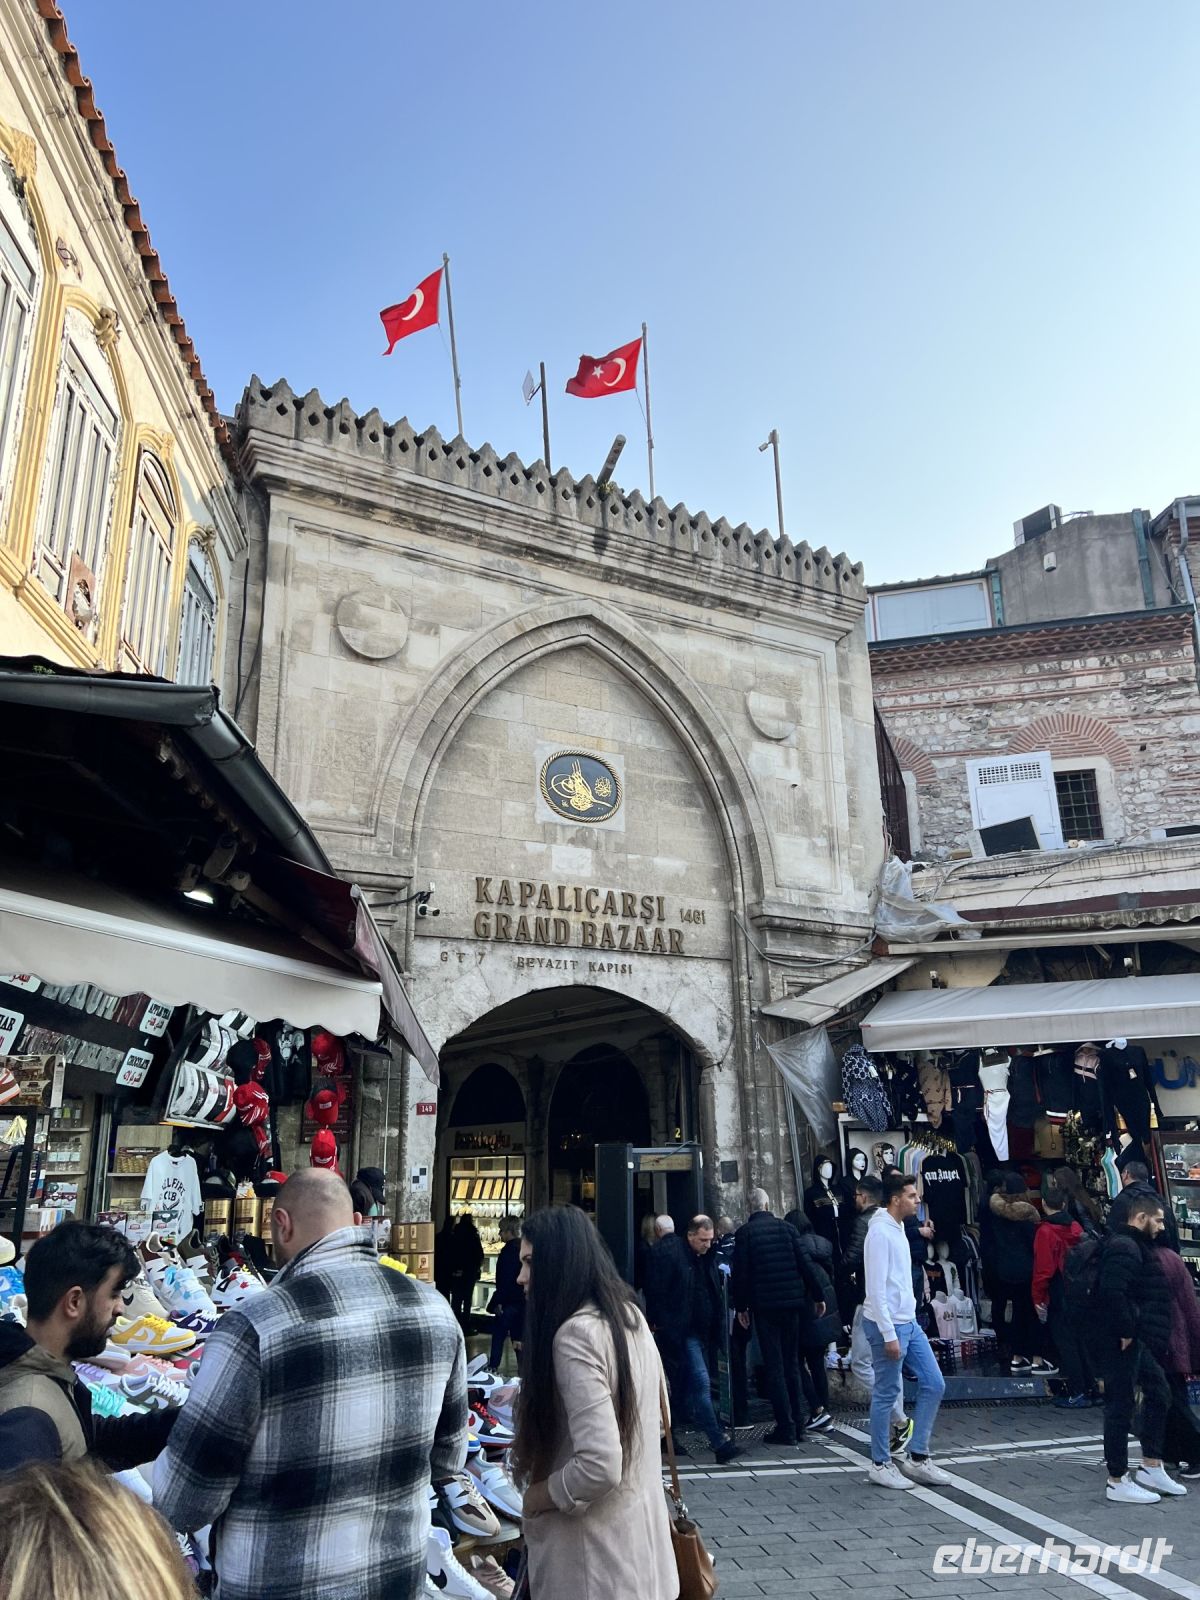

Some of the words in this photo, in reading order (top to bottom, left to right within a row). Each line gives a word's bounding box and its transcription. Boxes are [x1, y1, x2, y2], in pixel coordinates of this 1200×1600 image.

[475, 876, 666, 924] KAPALIÇARŞI
[474, 911, 571, 945] GRAND
[581, 921, 685, 954] BAZAAR
[517, 956, 578, 970] BEYAZIT
[588, 962, 633, 974] KAPISI
[421, 1105, 433, 1113] 149
[675, 1127, 681, 1139] 2
